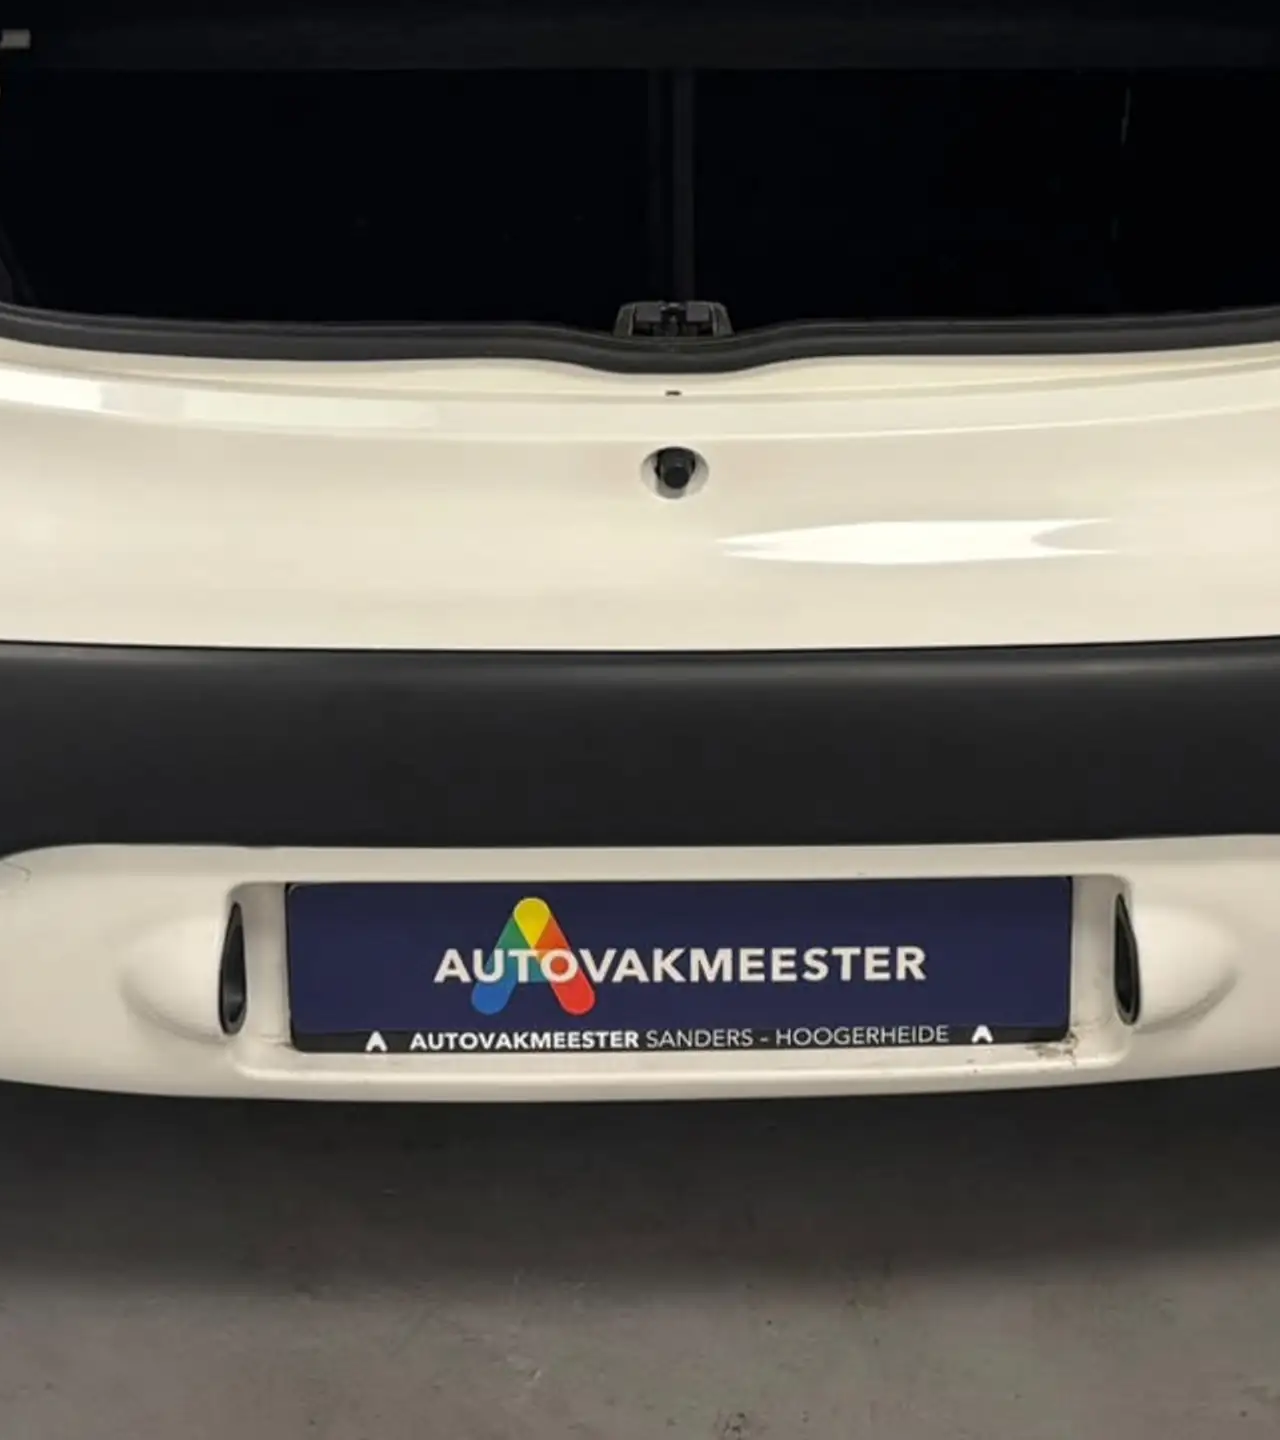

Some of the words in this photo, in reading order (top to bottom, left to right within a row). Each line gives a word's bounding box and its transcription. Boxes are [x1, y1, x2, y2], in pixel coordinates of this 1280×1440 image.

[433, 946, 927, 983] AUTOVAKMEESTER
[410, 1030, 640, 1051] AUTOVAKMEESTER
[646, 1027, 754, 1048] SANDERS
[776, 1025, 949, 1046] HOOGERHEIDE
